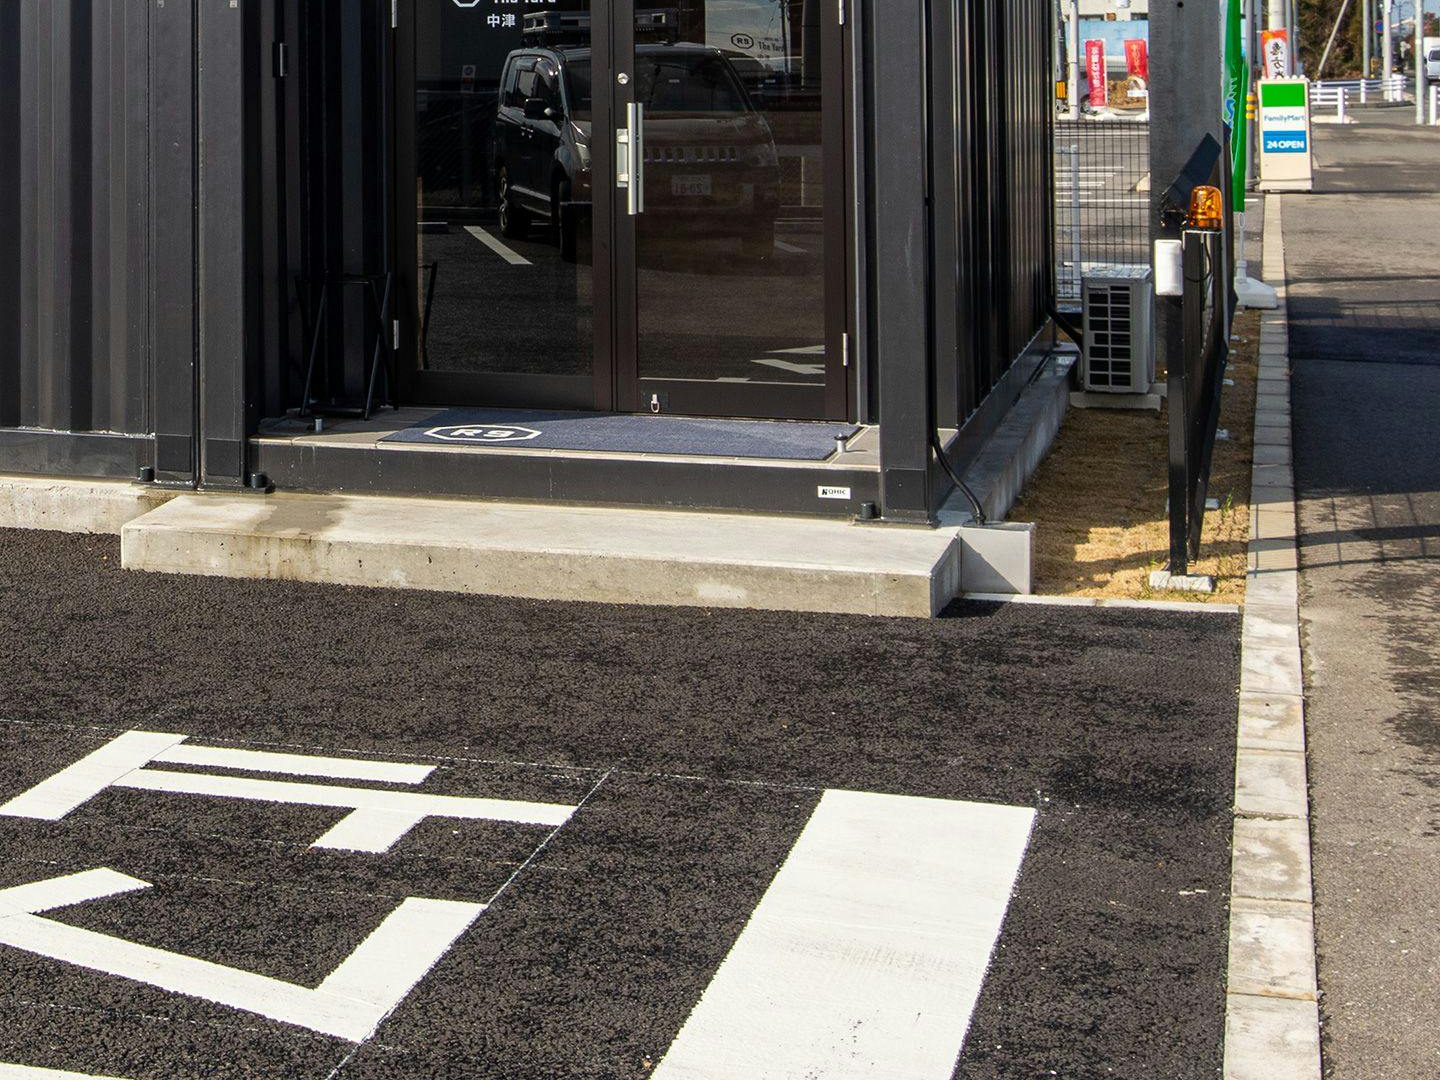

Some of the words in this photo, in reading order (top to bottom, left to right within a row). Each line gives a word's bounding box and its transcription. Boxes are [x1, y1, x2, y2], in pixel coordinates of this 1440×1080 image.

[487, 13, 516, 28] 中津
[1264, 114, 1305, 123] FamilyMart
[449, 428, 516, 438] R9
